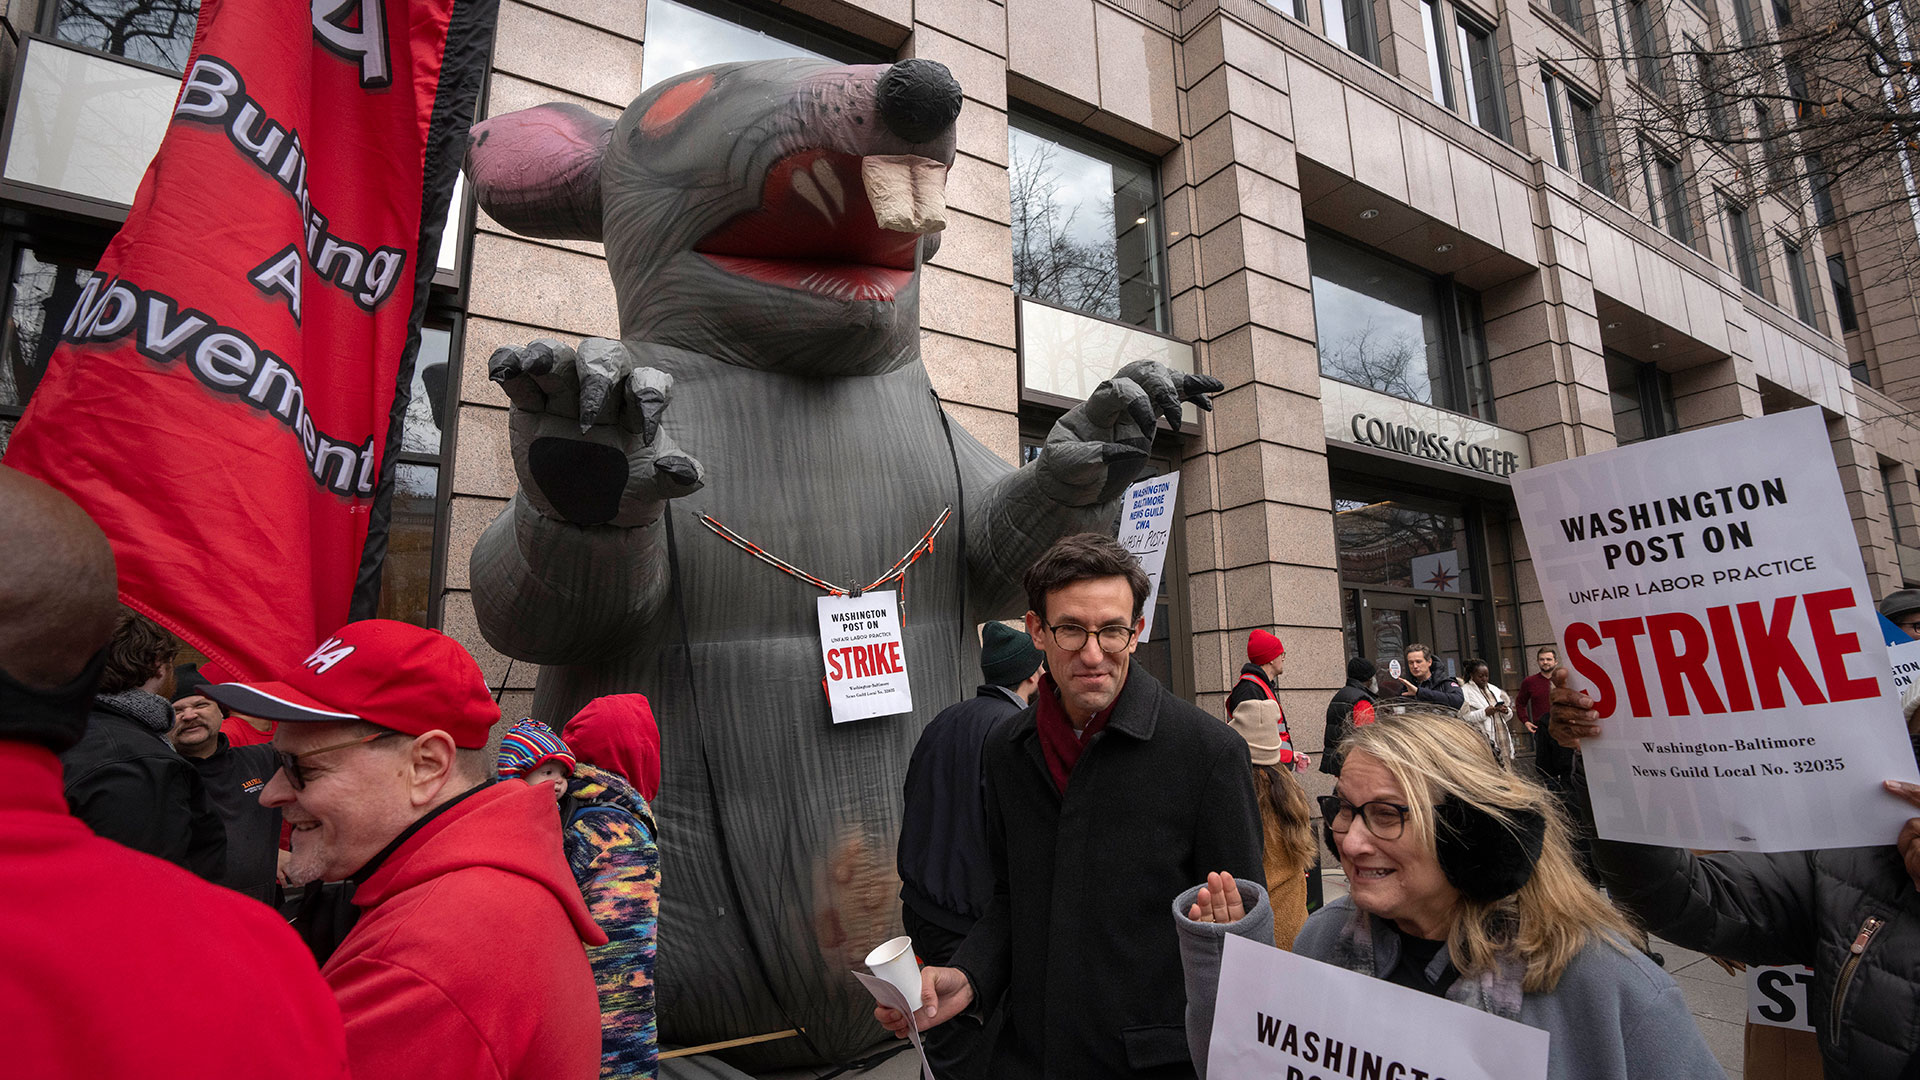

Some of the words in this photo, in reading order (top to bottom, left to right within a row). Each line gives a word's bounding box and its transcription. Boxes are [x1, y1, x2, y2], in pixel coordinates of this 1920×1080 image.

[174, 58, 403, 306] Building
[254, 250, 301, 322] A
[62, 276, 375, 494] Movement
[1351, 413, 1452, 462] COMPASS
[1453, 440, 1520, 476] COFFEE
[1133, 483, 1169, 498] WASHINGTON
[1133, 495, 1164, 509] BALTIMORE
[1560, 476, 1789, 543] WASHINGTON
[1130, 510, 1143, 520] NEWS
[1144, 506, 1164, 518] GUILD
[1135, 520, 1150, 530] CWA
[1602, 532, 1687, 571] POST
[1701, 520, 1754, 555] ON
[1568, 585, 1631, 606] UNFAIR
[1636, 573, 1706, 597] LABOR
[1713, 555, 1818, 585] PRACTICE
[831, 608, 887, 622] WASHINGTON
[842, 622, 864, 632] POST
[867, 620, 879, 629] ON
[830, 636, 849, 644] UNFAIR
[868, 631, 892, 639] PRACTICE
[827, 641, 903, 680] STRIKE
[1563, 586, 1882, 720] STRIKE
[1894, 675, 1912, 687] ON
[1642, 735, 1816, 756] Washington-Baltimore
[1632, 764, 1667, 778] News
[1670, 764, 1709, 778] Guild
[1713, 763, 1756, 778] Local
[1761, 762, 1789, 777] No.
[1793, 757, 1845, 775] 32035
